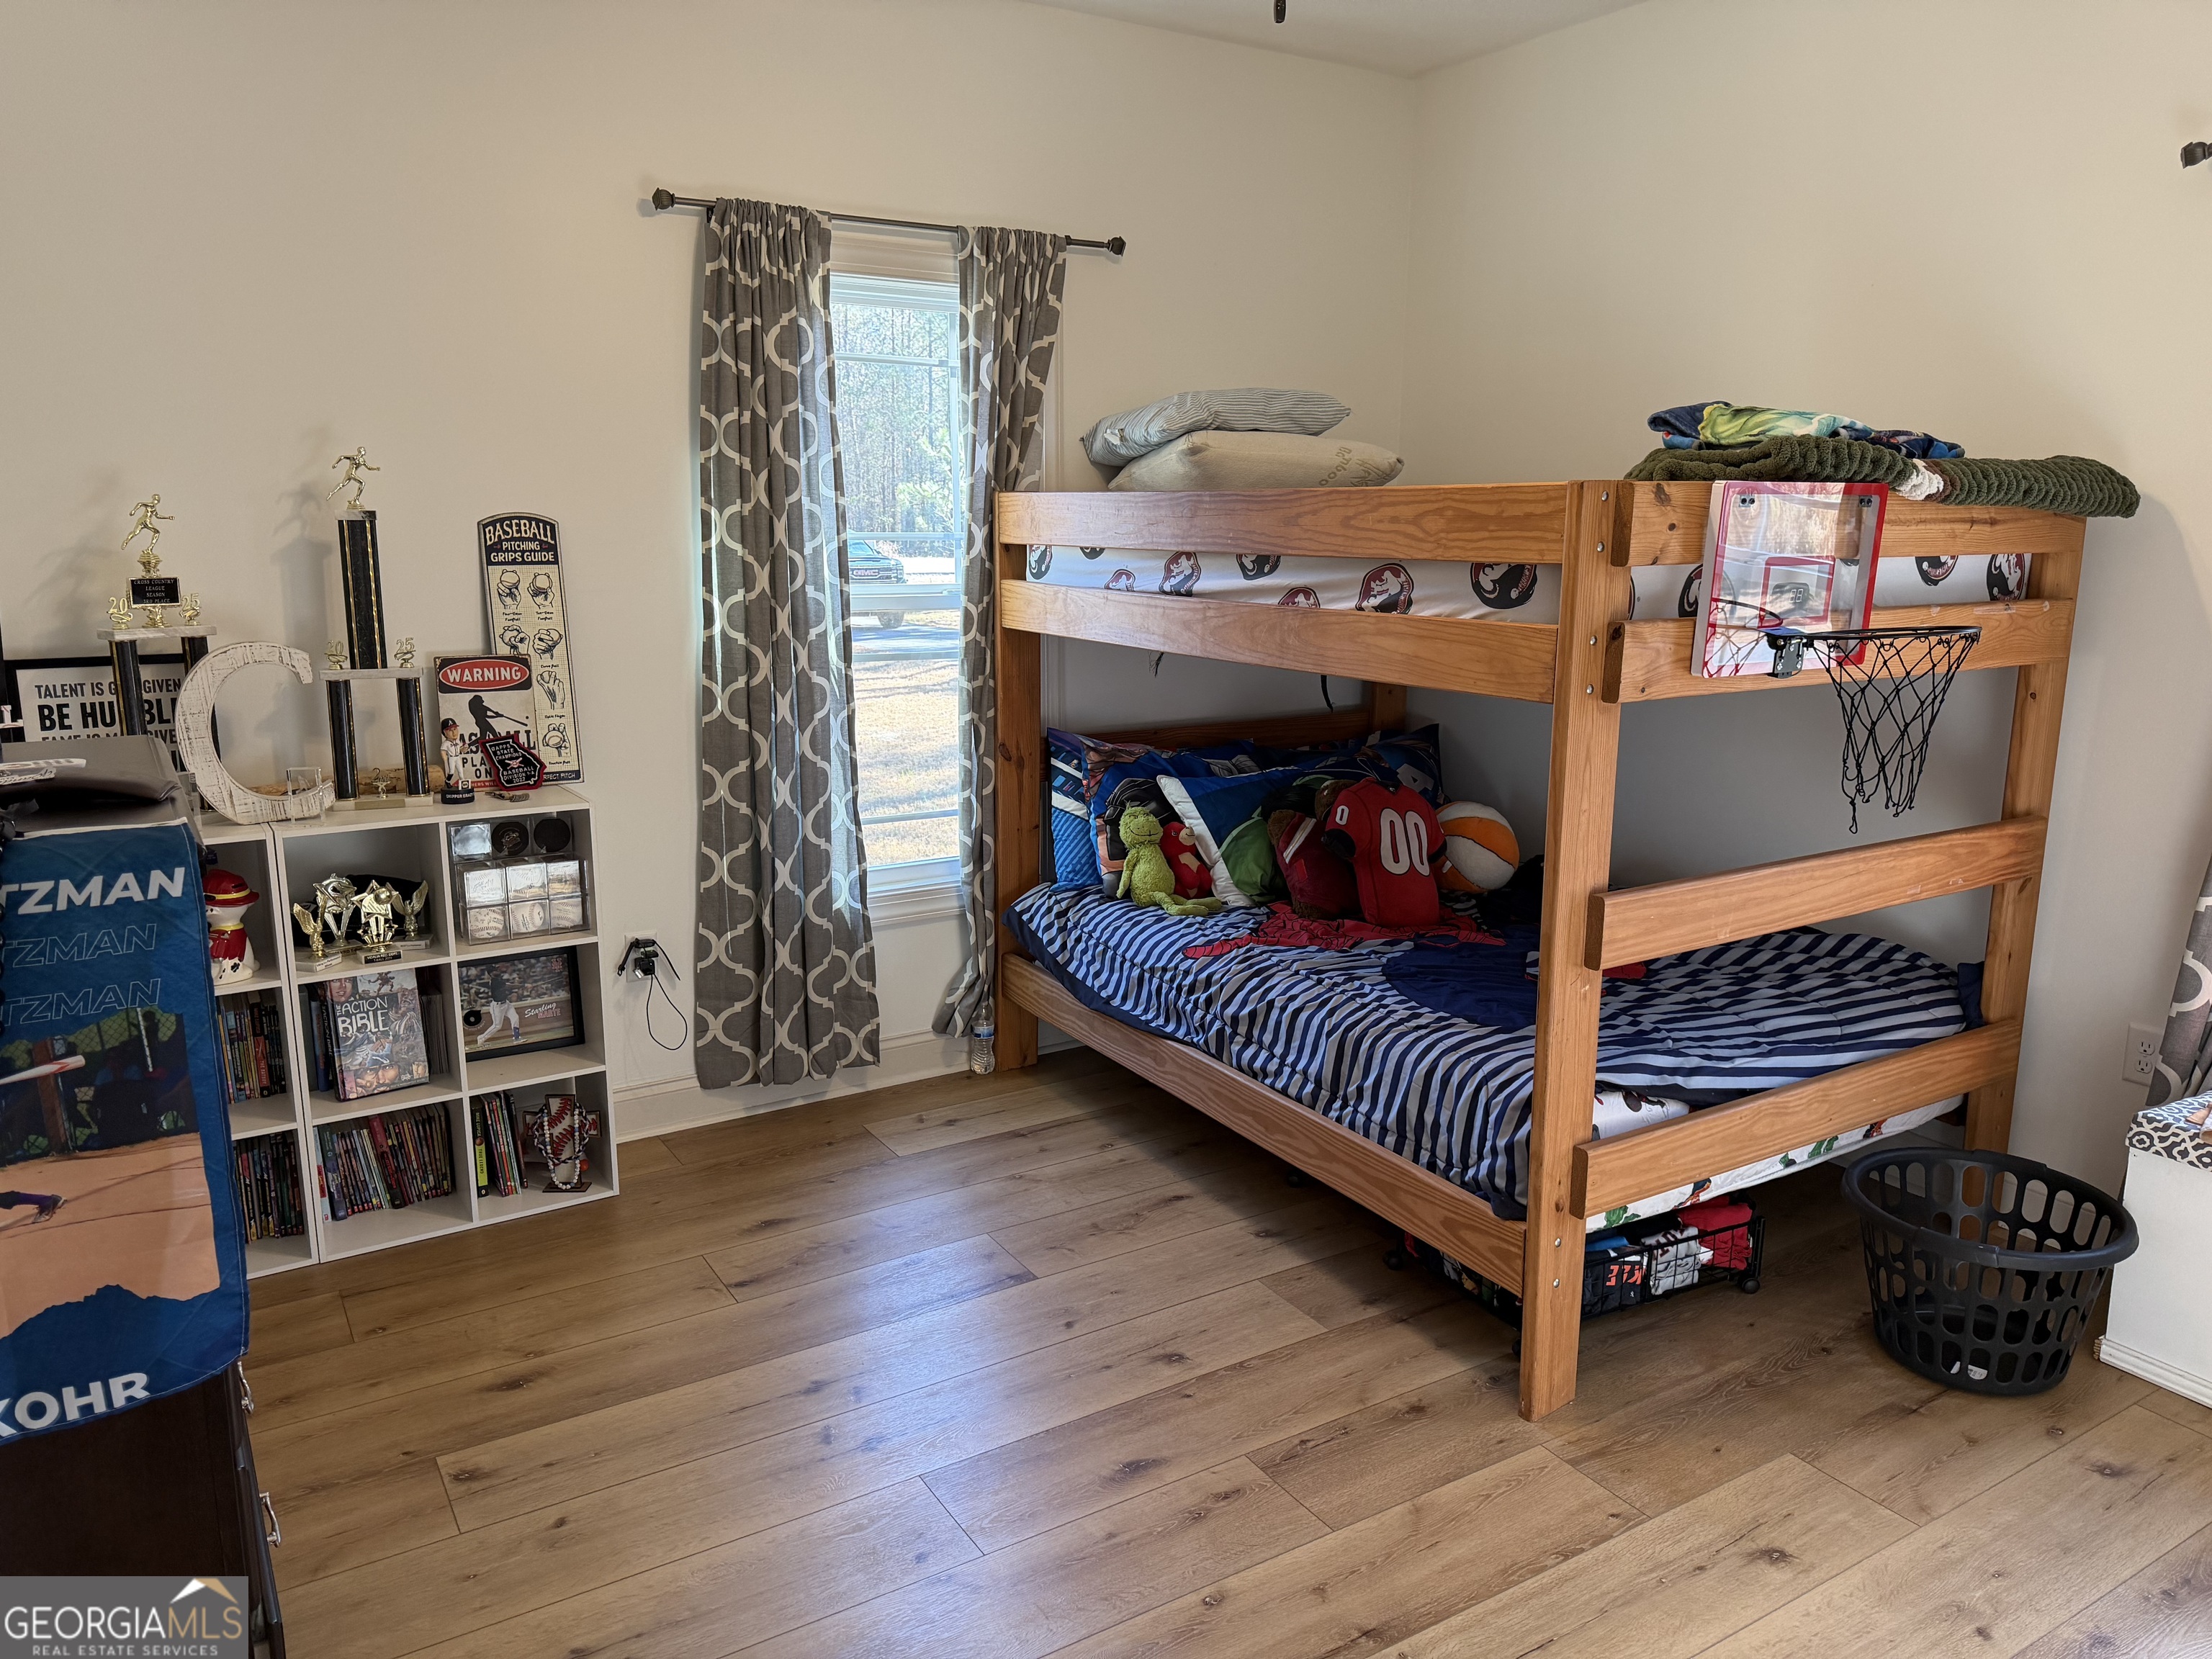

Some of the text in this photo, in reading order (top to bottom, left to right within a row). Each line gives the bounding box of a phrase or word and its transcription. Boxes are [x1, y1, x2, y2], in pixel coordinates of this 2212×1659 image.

[485, 519, 555, 546] BASEBALL
[502, 541, 540, 551] PITCHING
[490, 552, 554, 562] GRIPS GUIDE
[107, 597, 128, 613] 20
[181, 593, 200, 611] 25
[446, 667, 521, 683] WARNING
[35, 683, 86, 699] TALENT
[91, 682, 104, 696] IS
[143, 678, 181, 693] GIVEN
[37, 703, 73, 732] BE
[495, 752, 522, 760] CHAMPIONS
[503, 766, 534, 775] BASEBALL
[1335, 805, 1349, 825] 0
[1380, 806, 1430, 876] 00
[0, 867, 185, 914] TZMAN
[342, 997, 388, 1015] ACTION
[525, 1002, 557, 1017] Starling
[338, 1010, 390, 1037] BIBLE
